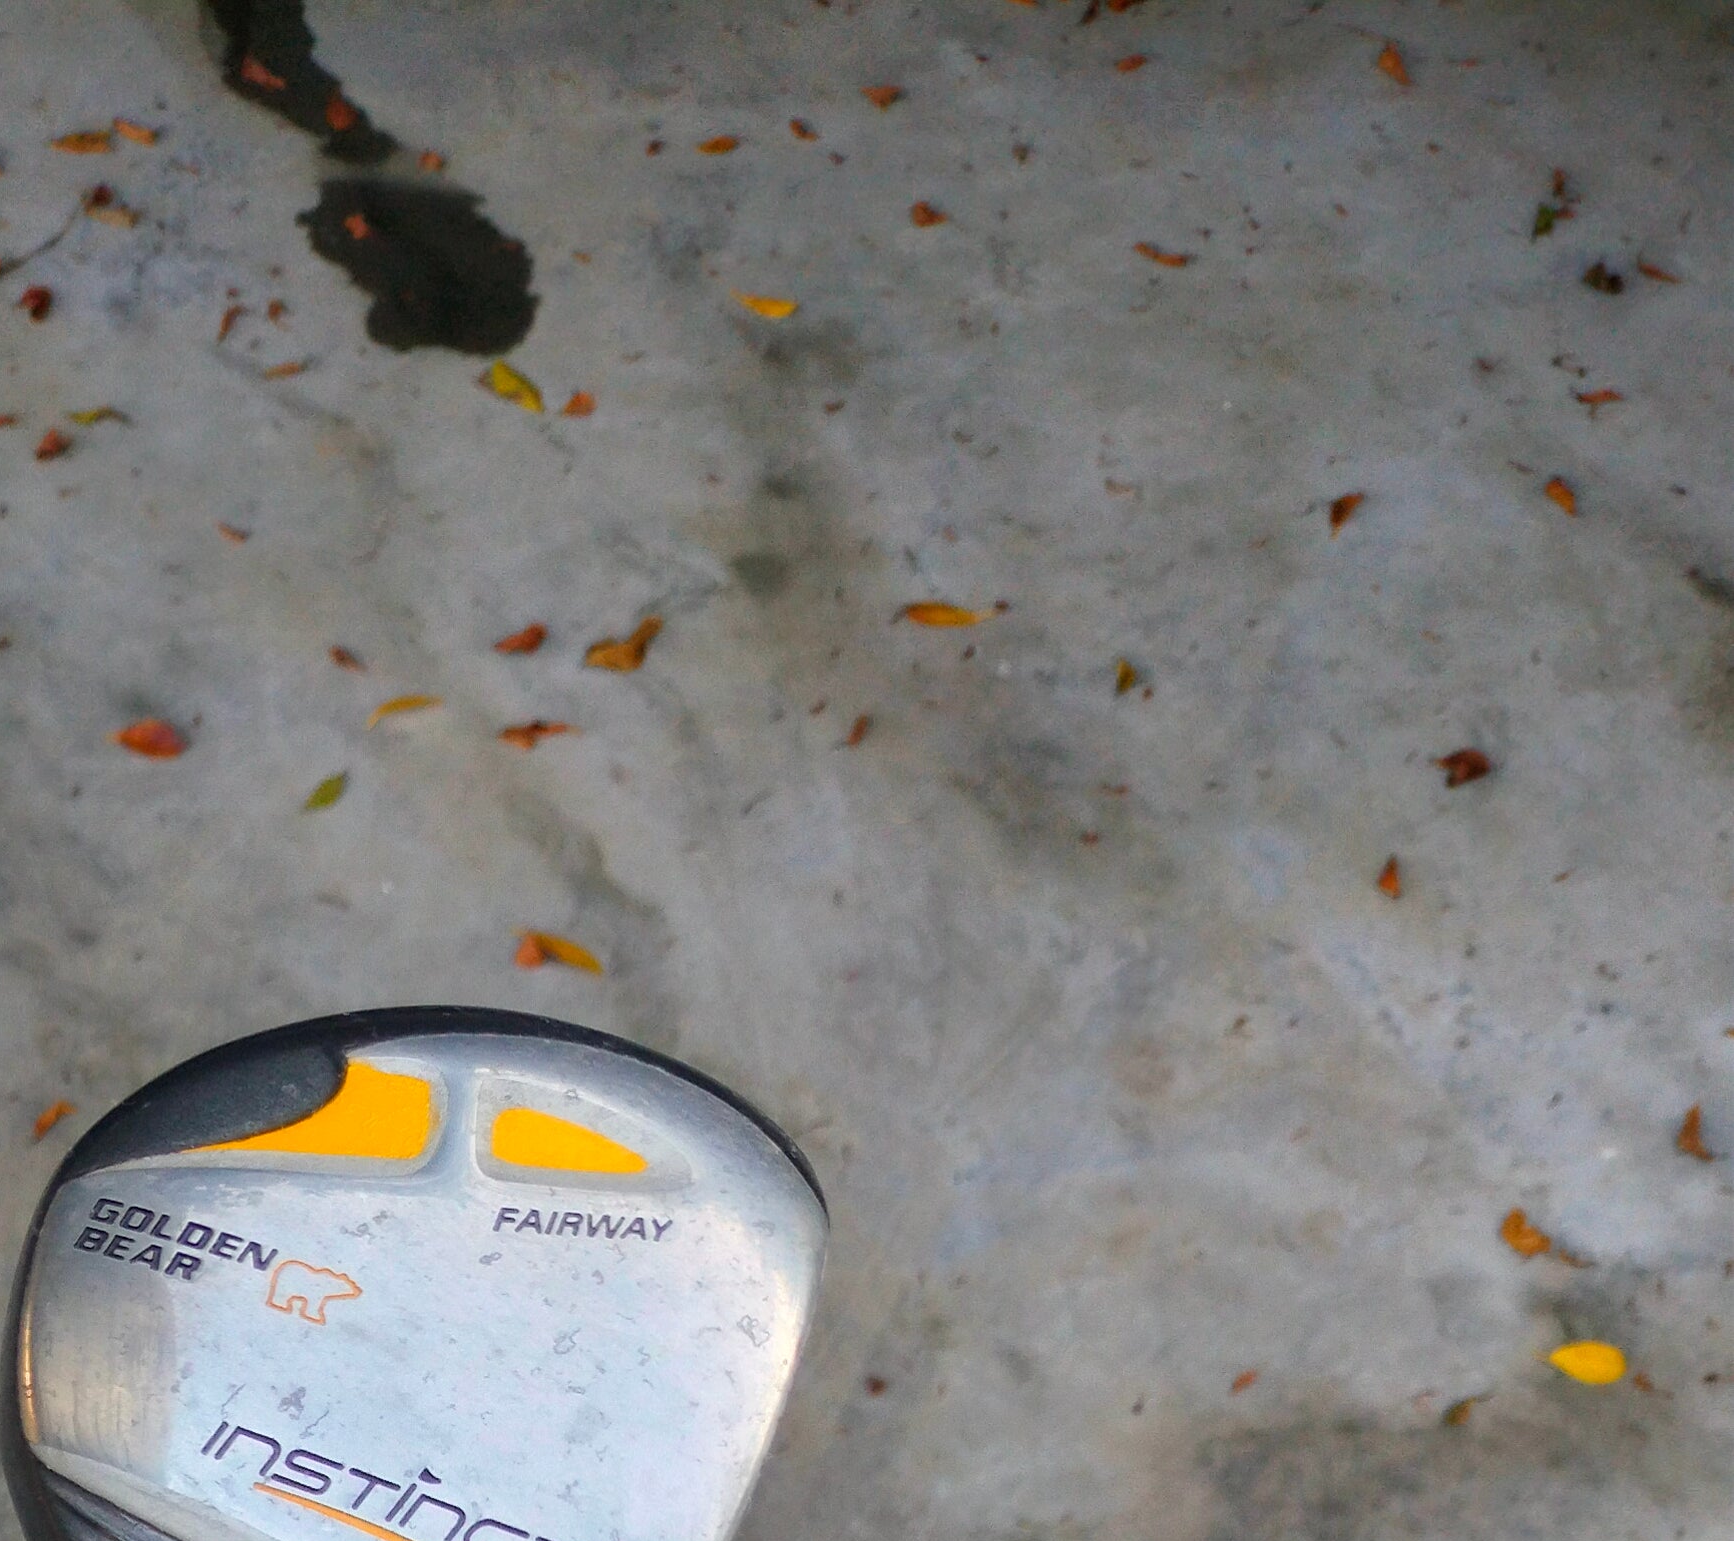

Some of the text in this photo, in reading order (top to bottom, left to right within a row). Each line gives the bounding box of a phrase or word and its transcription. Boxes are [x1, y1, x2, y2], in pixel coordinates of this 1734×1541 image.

[93, 1196, 278, 1270] GOLDEN
[493, 1207, 673, 1243] FAIRWAY
[73, 1227, 202, 1281] BEAR
